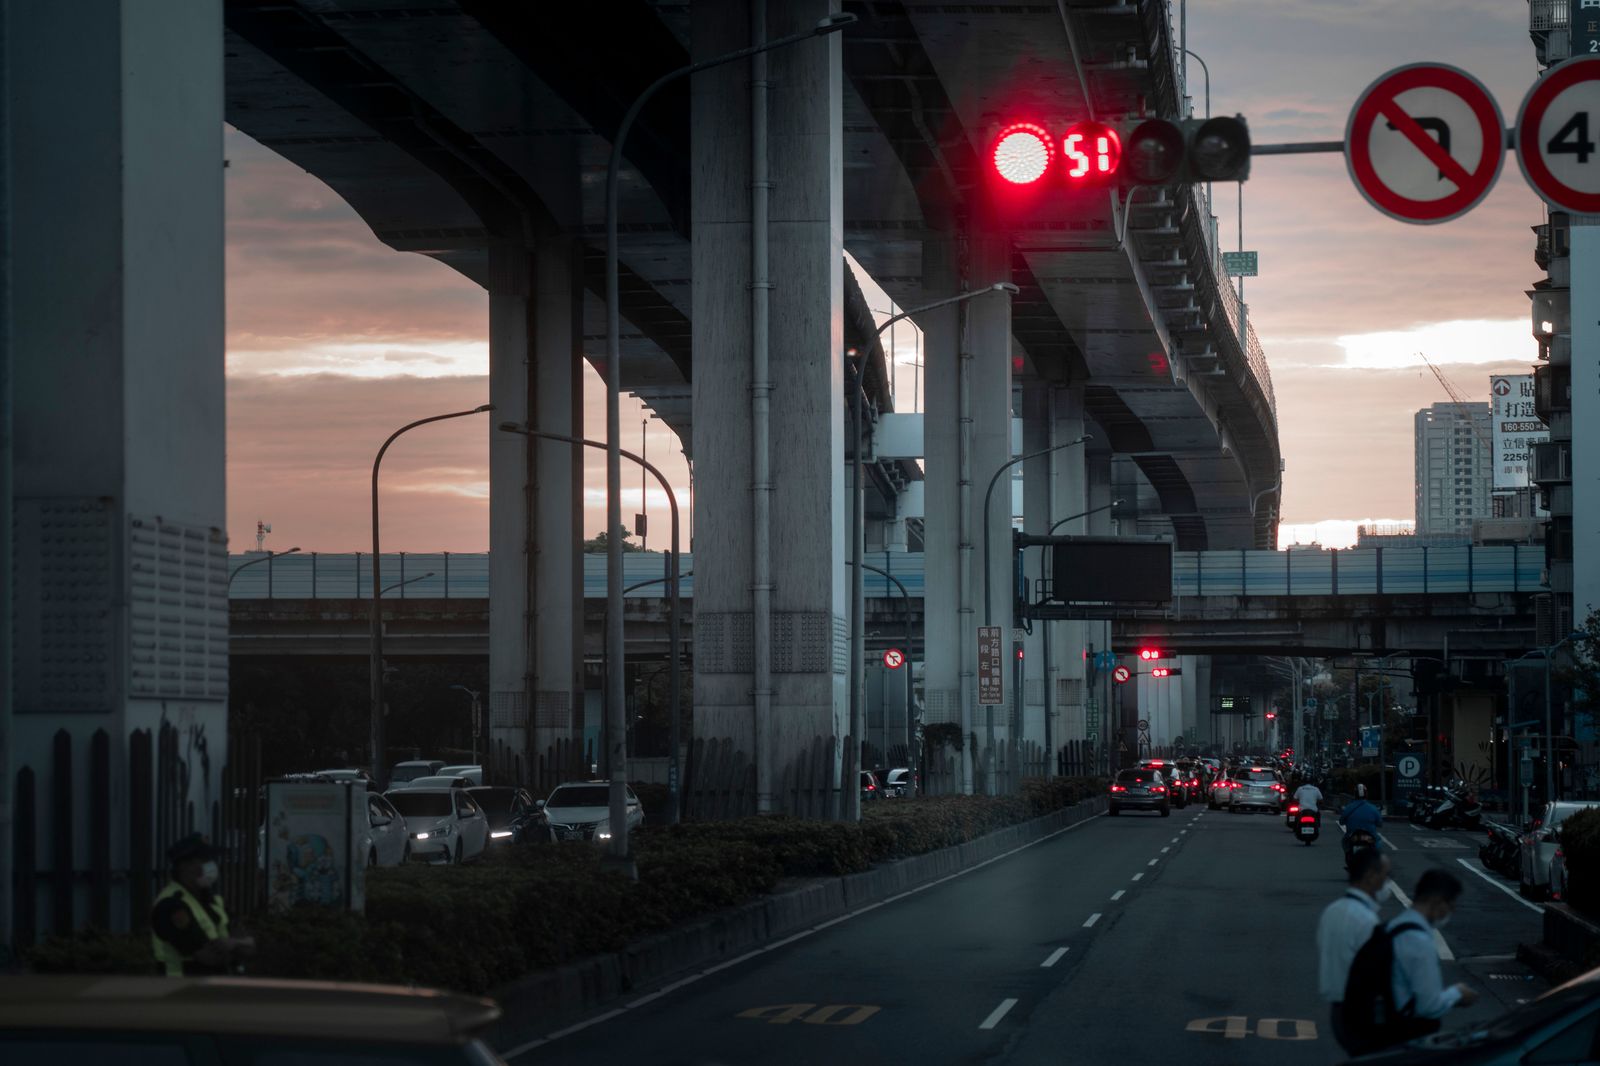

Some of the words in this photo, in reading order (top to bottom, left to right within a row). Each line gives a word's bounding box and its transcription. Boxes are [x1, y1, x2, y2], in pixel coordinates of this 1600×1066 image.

[1589, 39, 1600, 53] 2
[1063, 134, 1110, 177] 51
[1505, 402, 1535, 417] 打造
[1503, 453, 1529, 461] 2256
[1405, 760, 1414, 774] P
[734, 1003, 882, 1025] 40
[1184, 1016, 1319, 1041] 40
